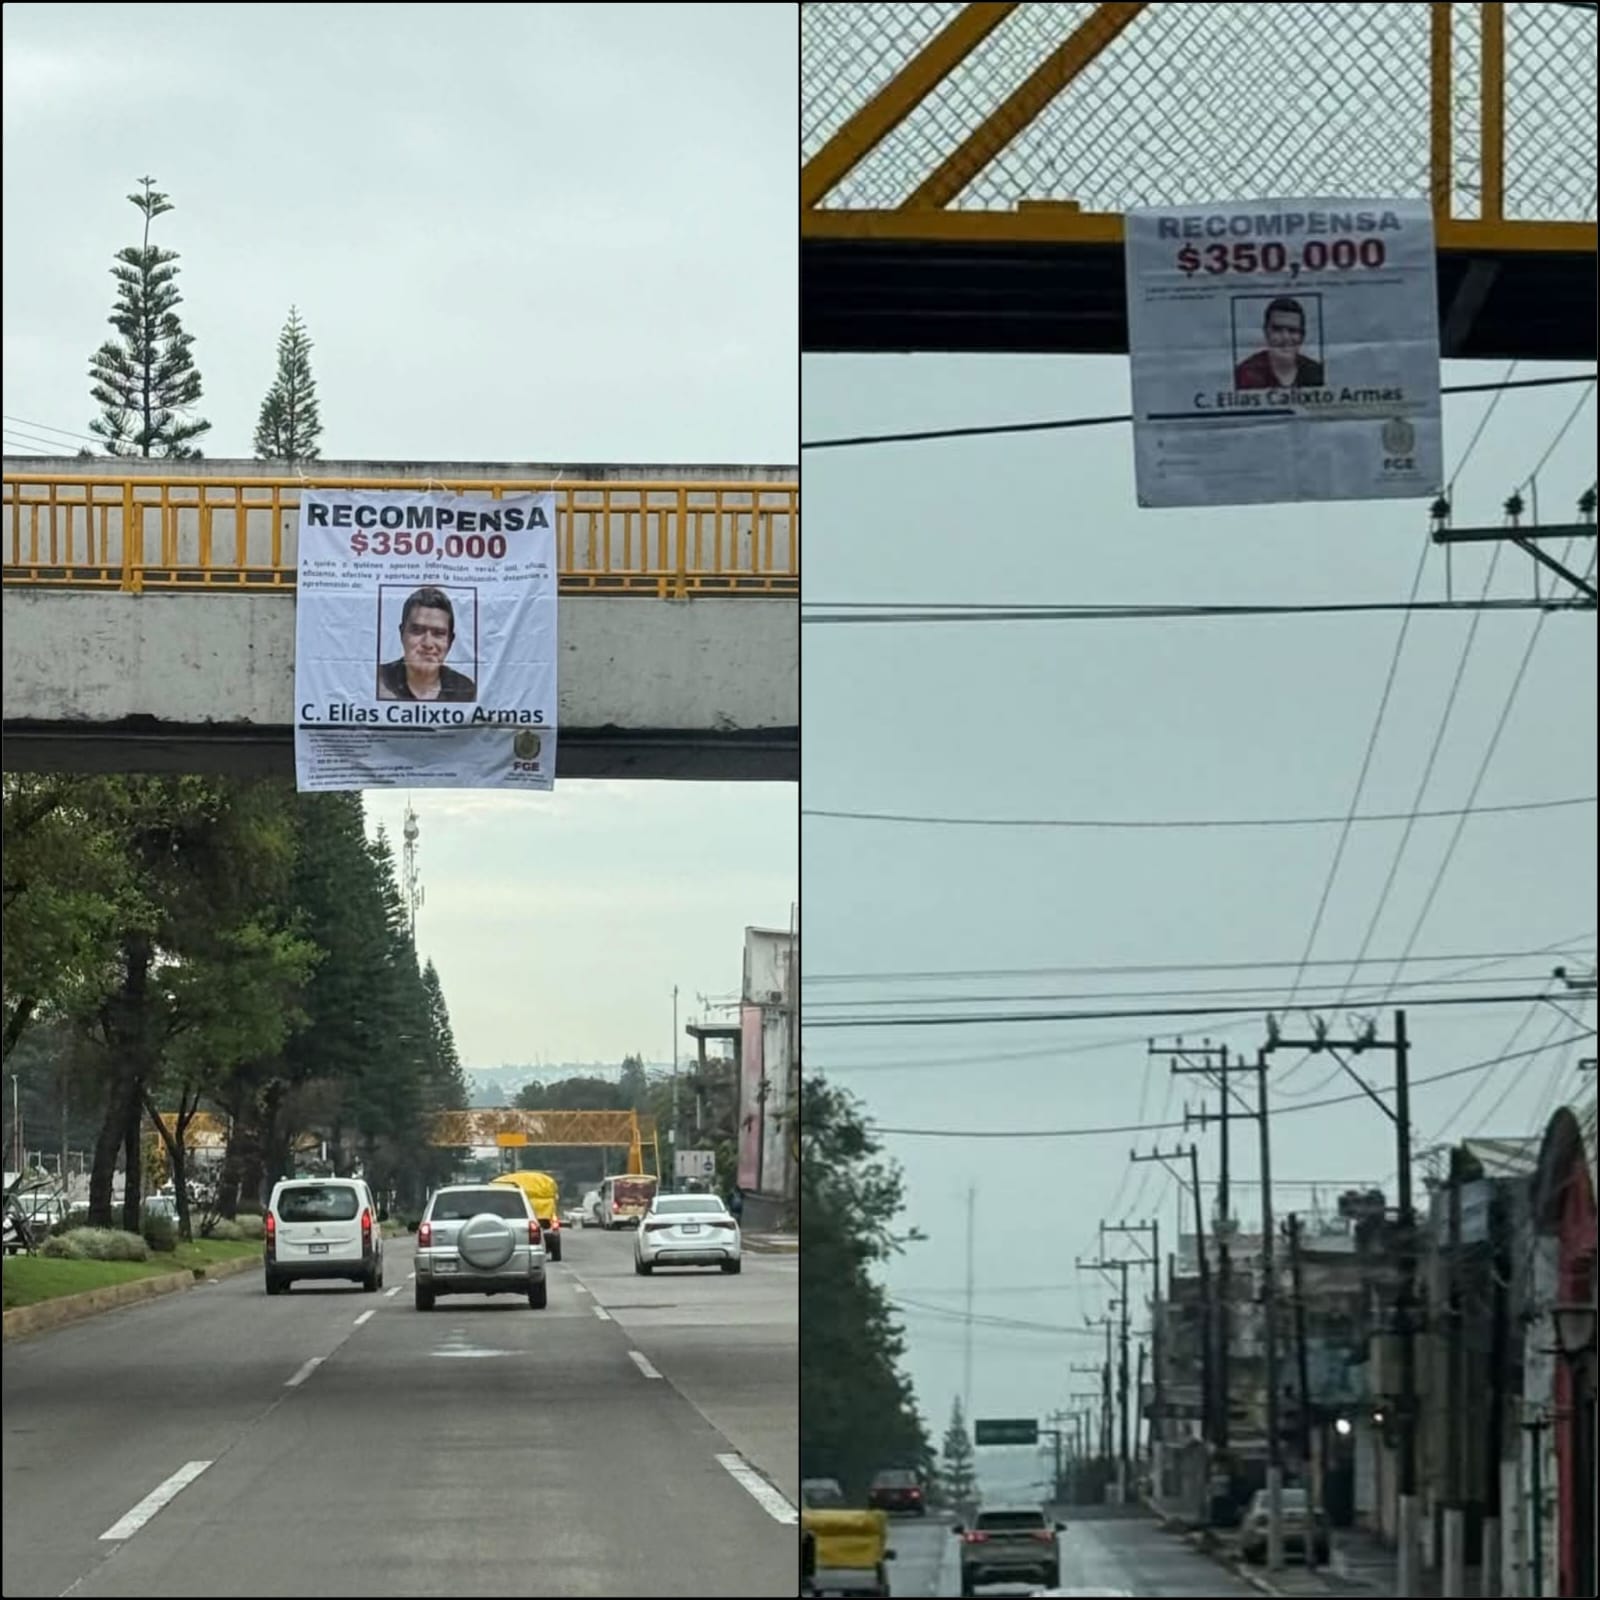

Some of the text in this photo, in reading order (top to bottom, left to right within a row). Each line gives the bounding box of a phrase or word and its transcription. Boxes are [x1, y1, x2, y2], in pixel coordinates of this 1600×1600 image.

[1157, 211, 1402, 239] RECOMPENSA
[1176, 238, 1386, 278] $350,000
[1194, 392, 1211, 409] C.
[1266, 388, 1333, 406] Calixto
[1340, 386, 1404, 403] Armas
[307, 503, 550, 532] RECOMPENSA
[350, 530, 508, 561] $350,000
[301, 702, 544, 724] C. Elías Calixto Armas
[513, 761, 540, 772] FGE
